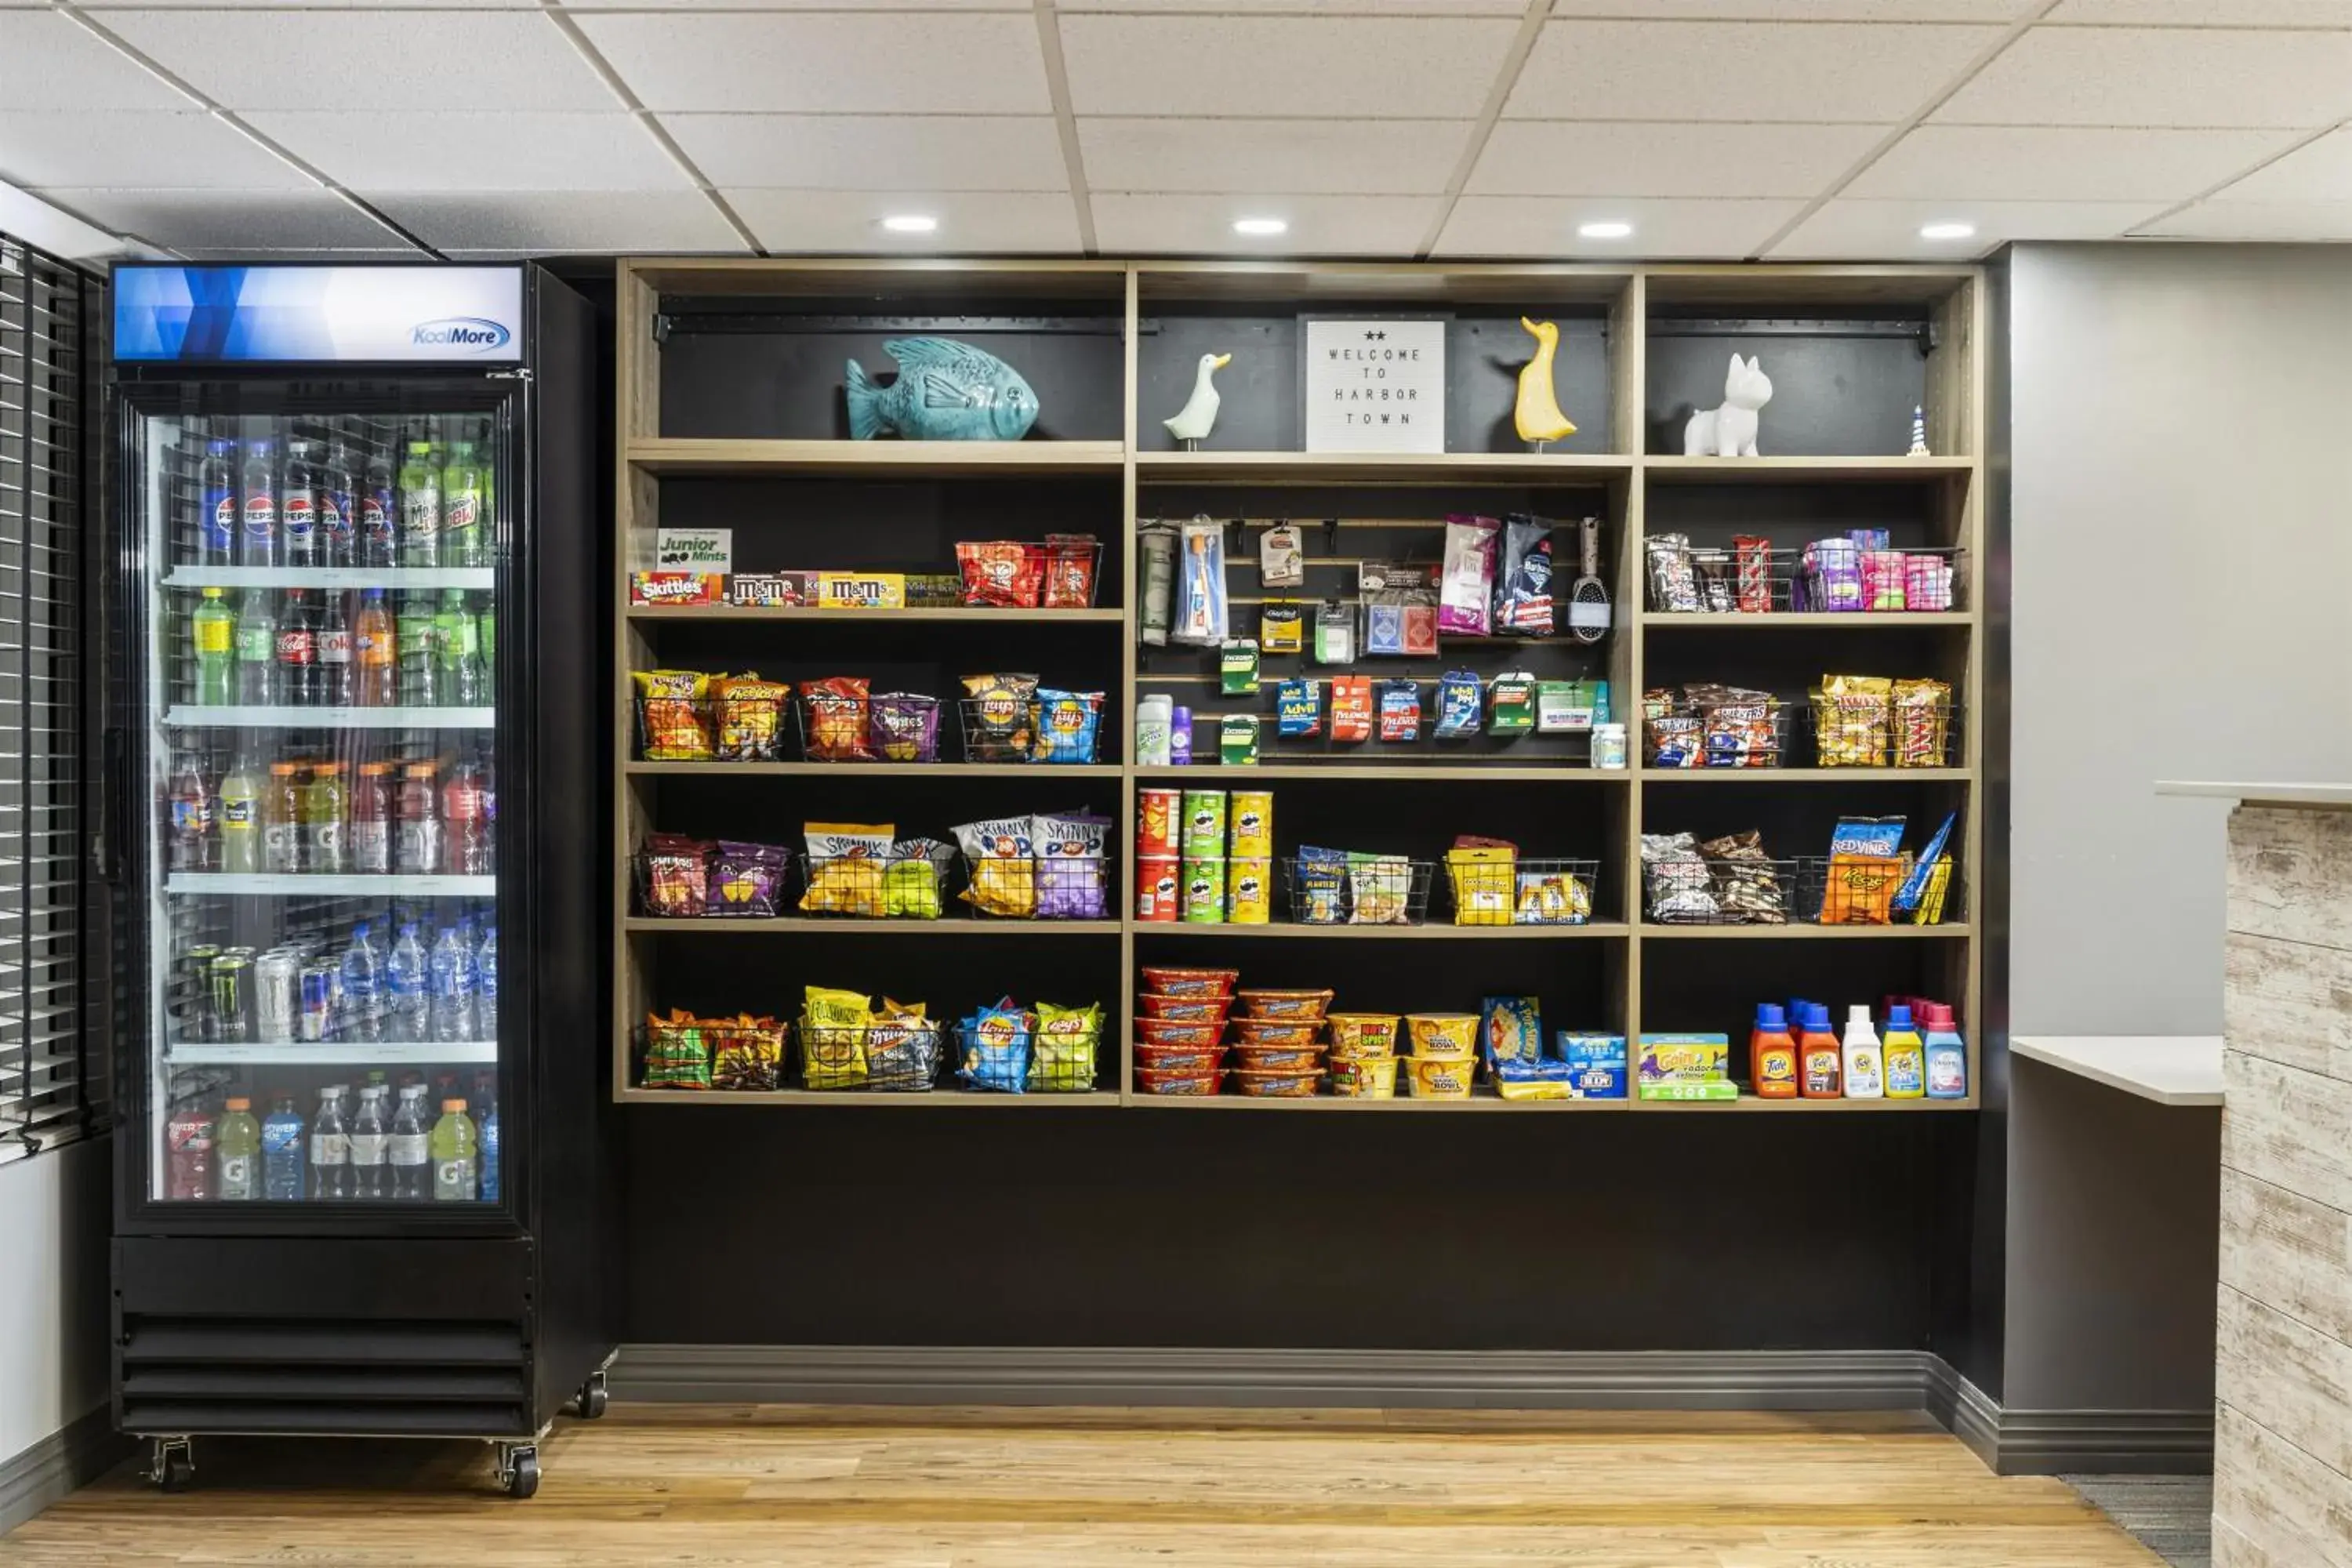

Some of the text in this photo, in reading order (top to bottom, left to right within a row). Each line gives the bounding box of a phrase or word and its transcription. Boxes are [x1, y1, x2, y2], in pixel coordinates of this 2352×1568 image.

[413, 328, 496, 344] KoolMore
[1329, 348, 1420, 361] WELCOME
[1363, 368, 1386, 379] TO
[1334, 389, 1417, 401] HARBOR
[1346, 413, 1410, 424] TOWN
[660, 537, 717, 551] Junior
[691, 552, 727, 561] Mints
[642, 577, 702, 598] Skittles
[1283, 702, 1316, 715] Advil
[974, 820, 1028, 835] SKINNY
[1047, 821, 1099, 840] SKINNY
[1766, 1059, 1786, 1072] Tide
[225, 1160, 244, 1181] G
[439, 1163, 458, 1185] G
